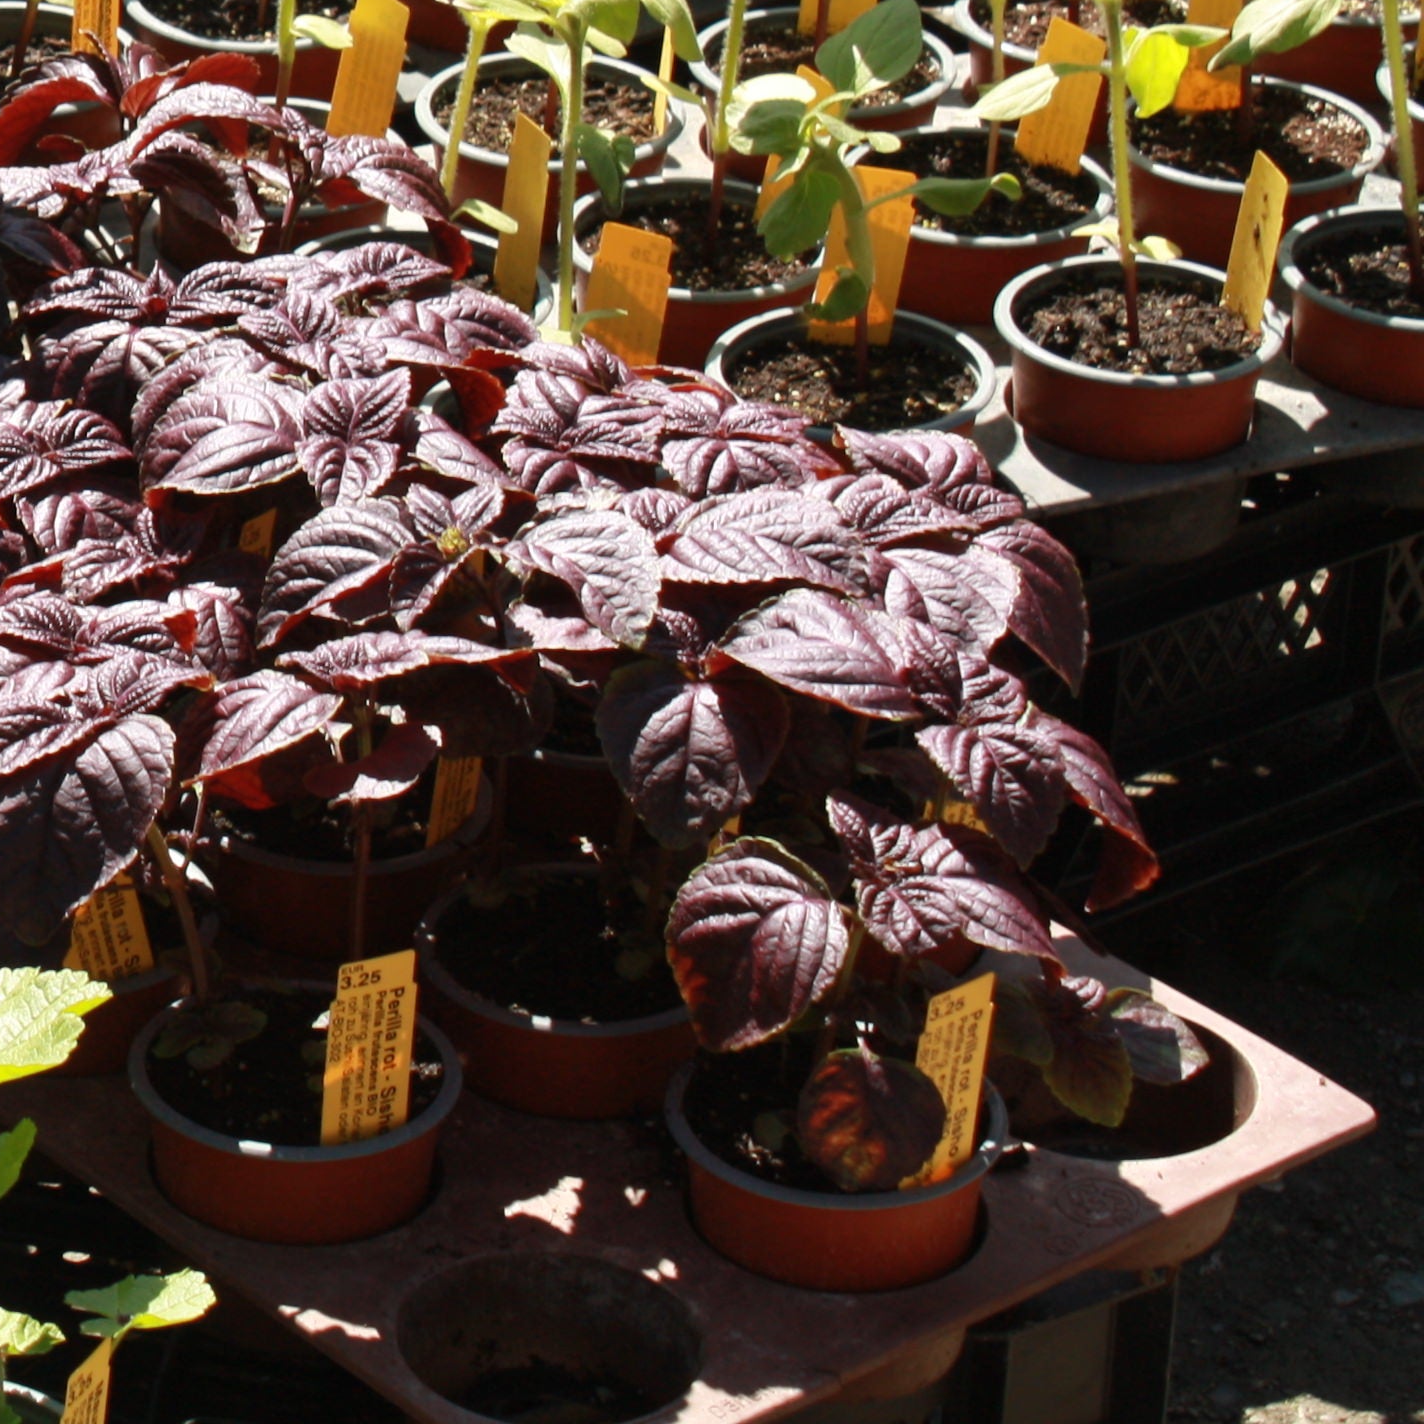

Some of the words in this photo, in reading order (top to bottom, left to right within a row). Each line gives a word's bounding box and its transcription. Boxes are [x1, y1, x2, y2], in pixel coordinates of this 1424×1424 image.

[340, 969, 382, 990] 3.25
[373, 990, 387, 1027] Perilla
[383, 986, 405, 1042] Perilla
[329, 1000, 345, 1063] AT-BIO-302
[962, 1009, 983, 1064] Perilla
[383, 1046, 399, 1071] rot
[958, 1068, 972, 1094] rot
[366, 1094, 379, 1117] BIO
